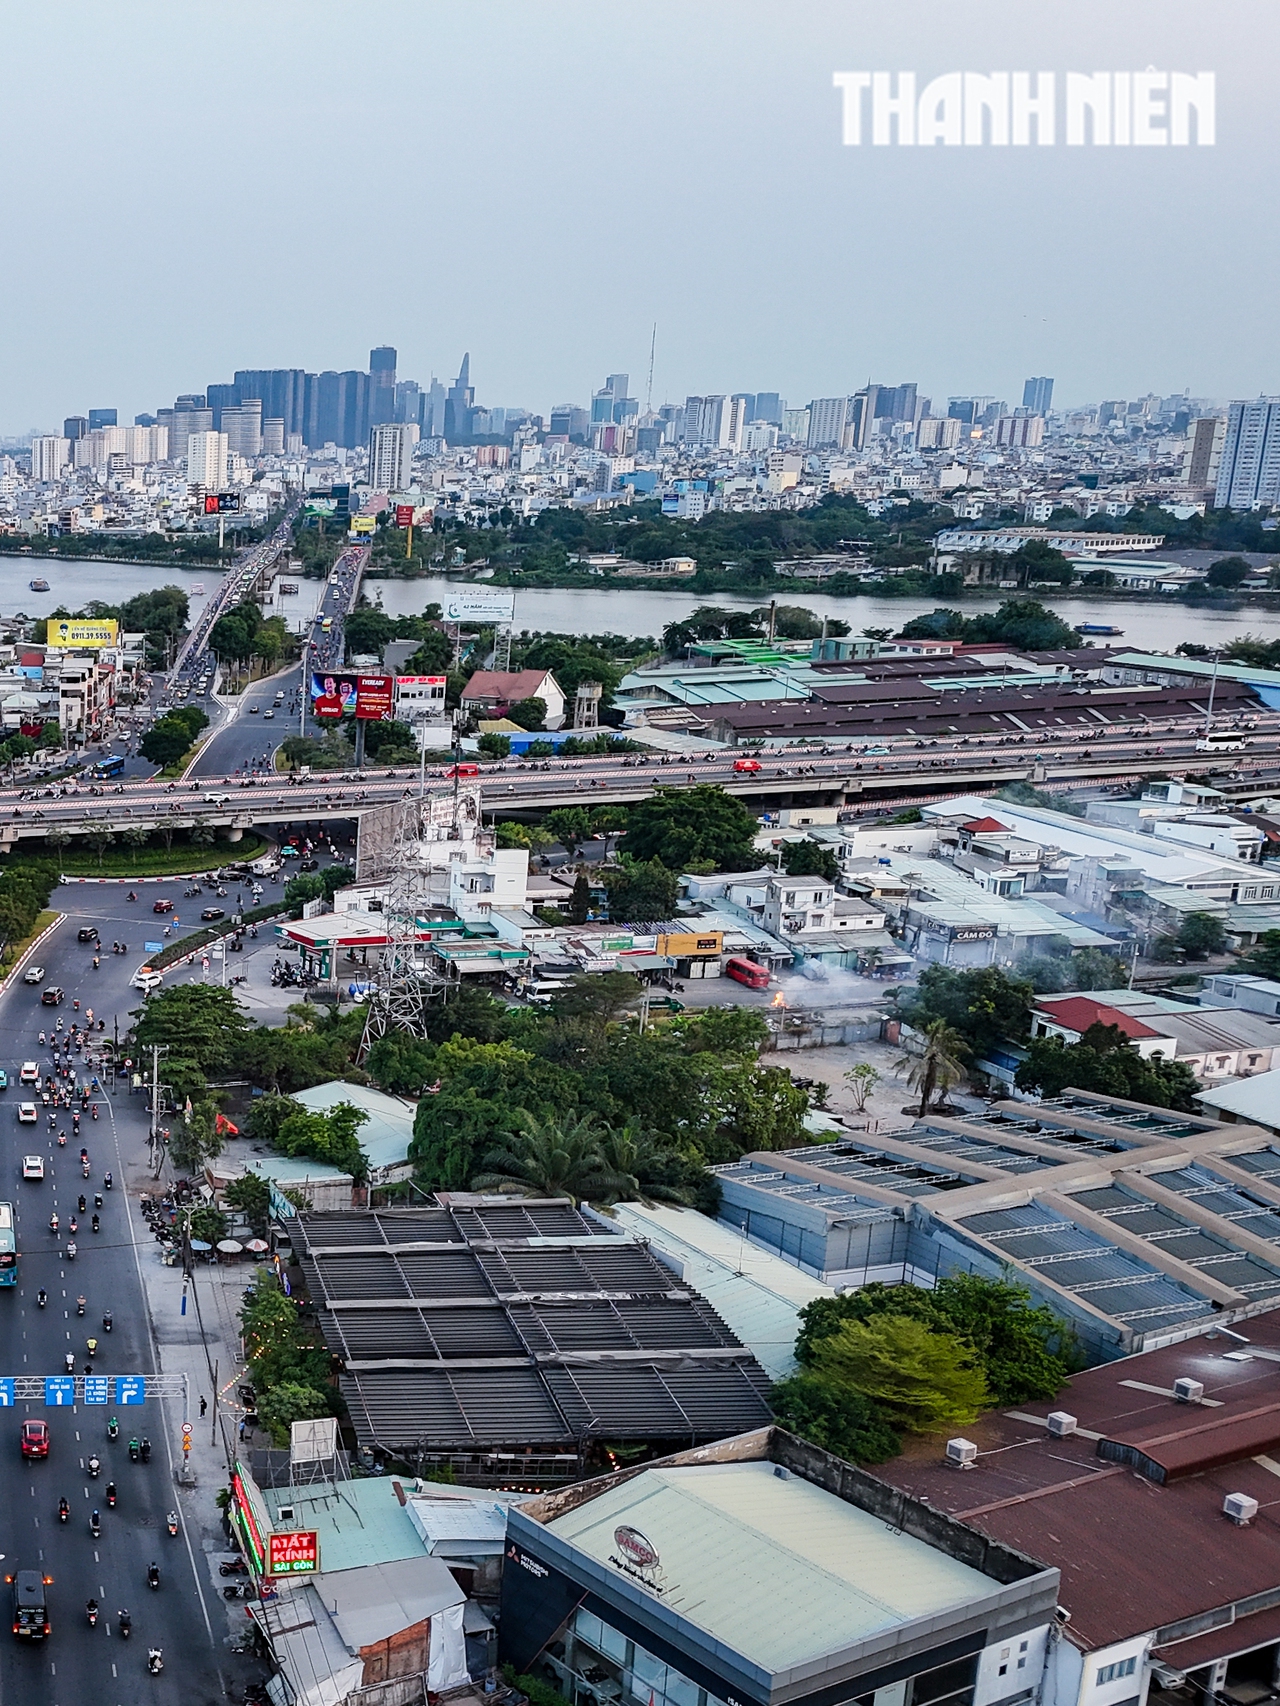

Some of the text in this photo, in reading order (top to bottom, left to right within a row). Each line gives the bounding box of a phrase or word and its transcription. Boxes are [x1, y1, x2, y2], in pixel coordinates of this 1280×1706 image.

[272, 1534, 311, 1549] MẮT
[617, 1532, 653, 1562] SAMCO
[273, 1549, 314, 1561] KÍNH
[274, 1561, 313, 1571] SÀI GÒN
[520, 1554, 549, 1577] MITSUBISHI
[520, 1560, 541, 1578] MOTORS
